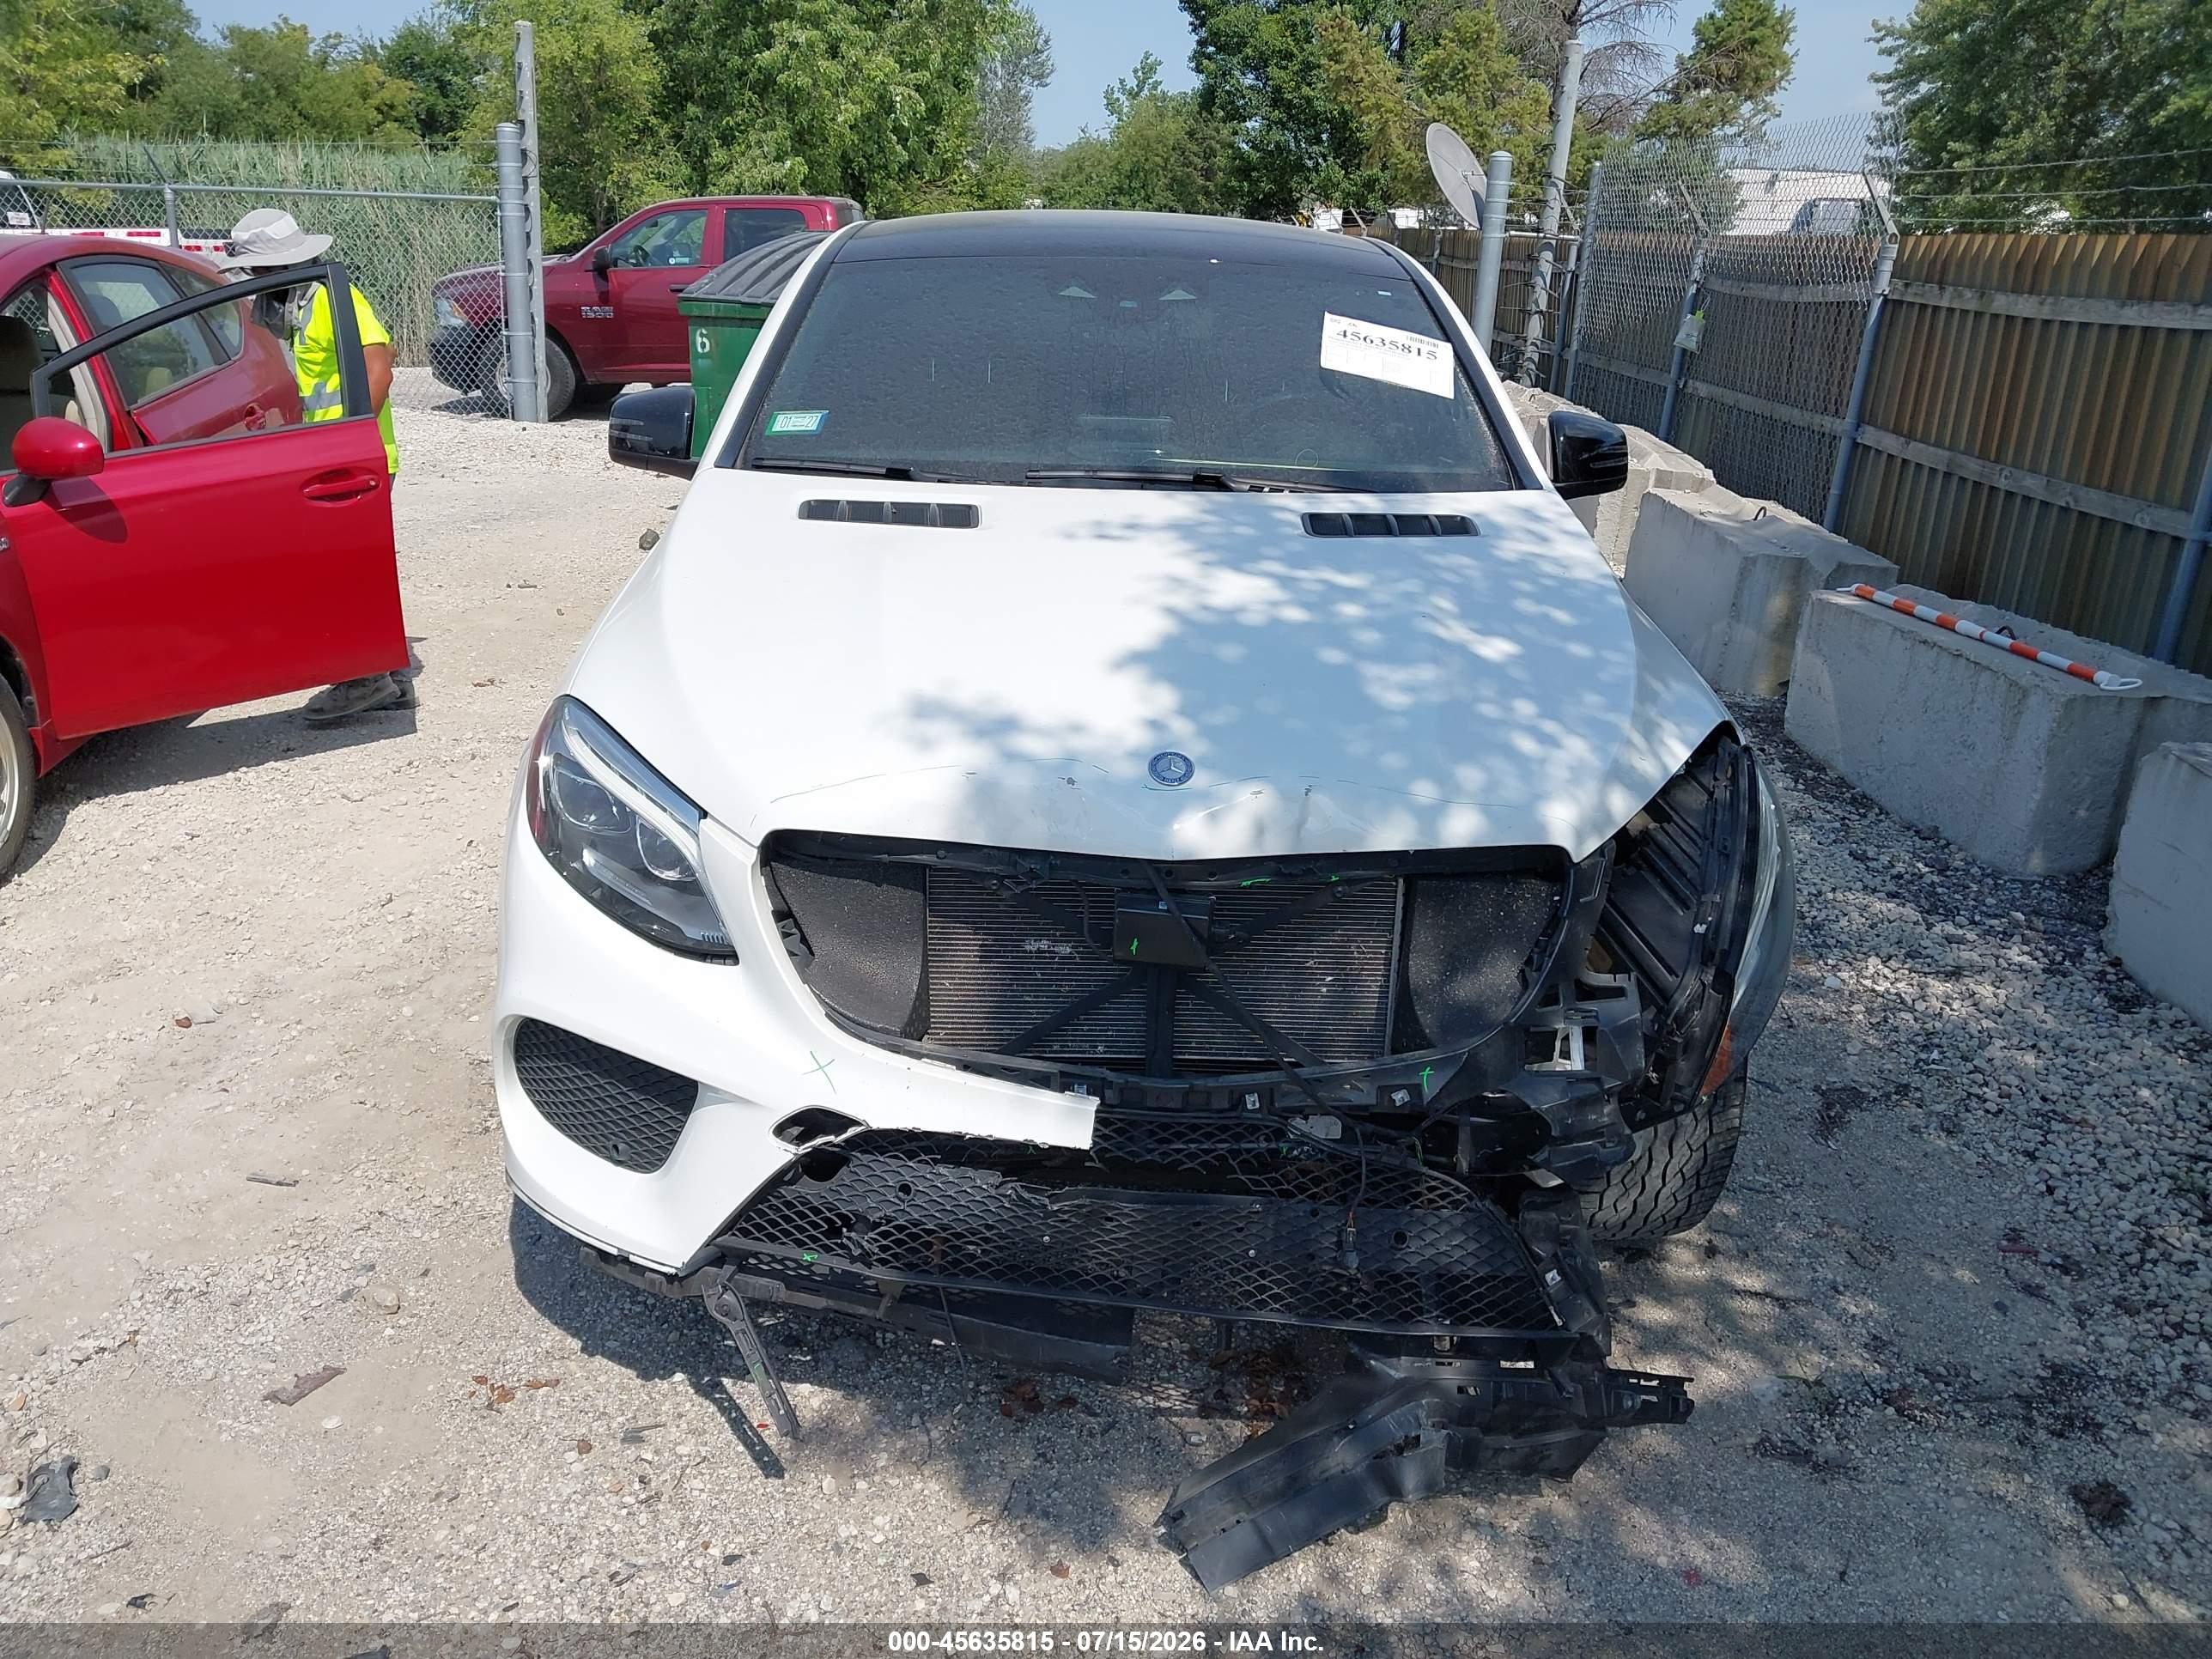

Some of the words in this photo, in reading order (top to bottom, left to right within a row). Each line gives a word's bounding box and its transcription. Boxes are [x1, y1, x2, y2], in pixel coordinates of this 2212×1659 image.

[696, 327, 710, 353] 6
[1336, 329, 1437, 360] 45635815
[804, 415, 819, 428] 27
